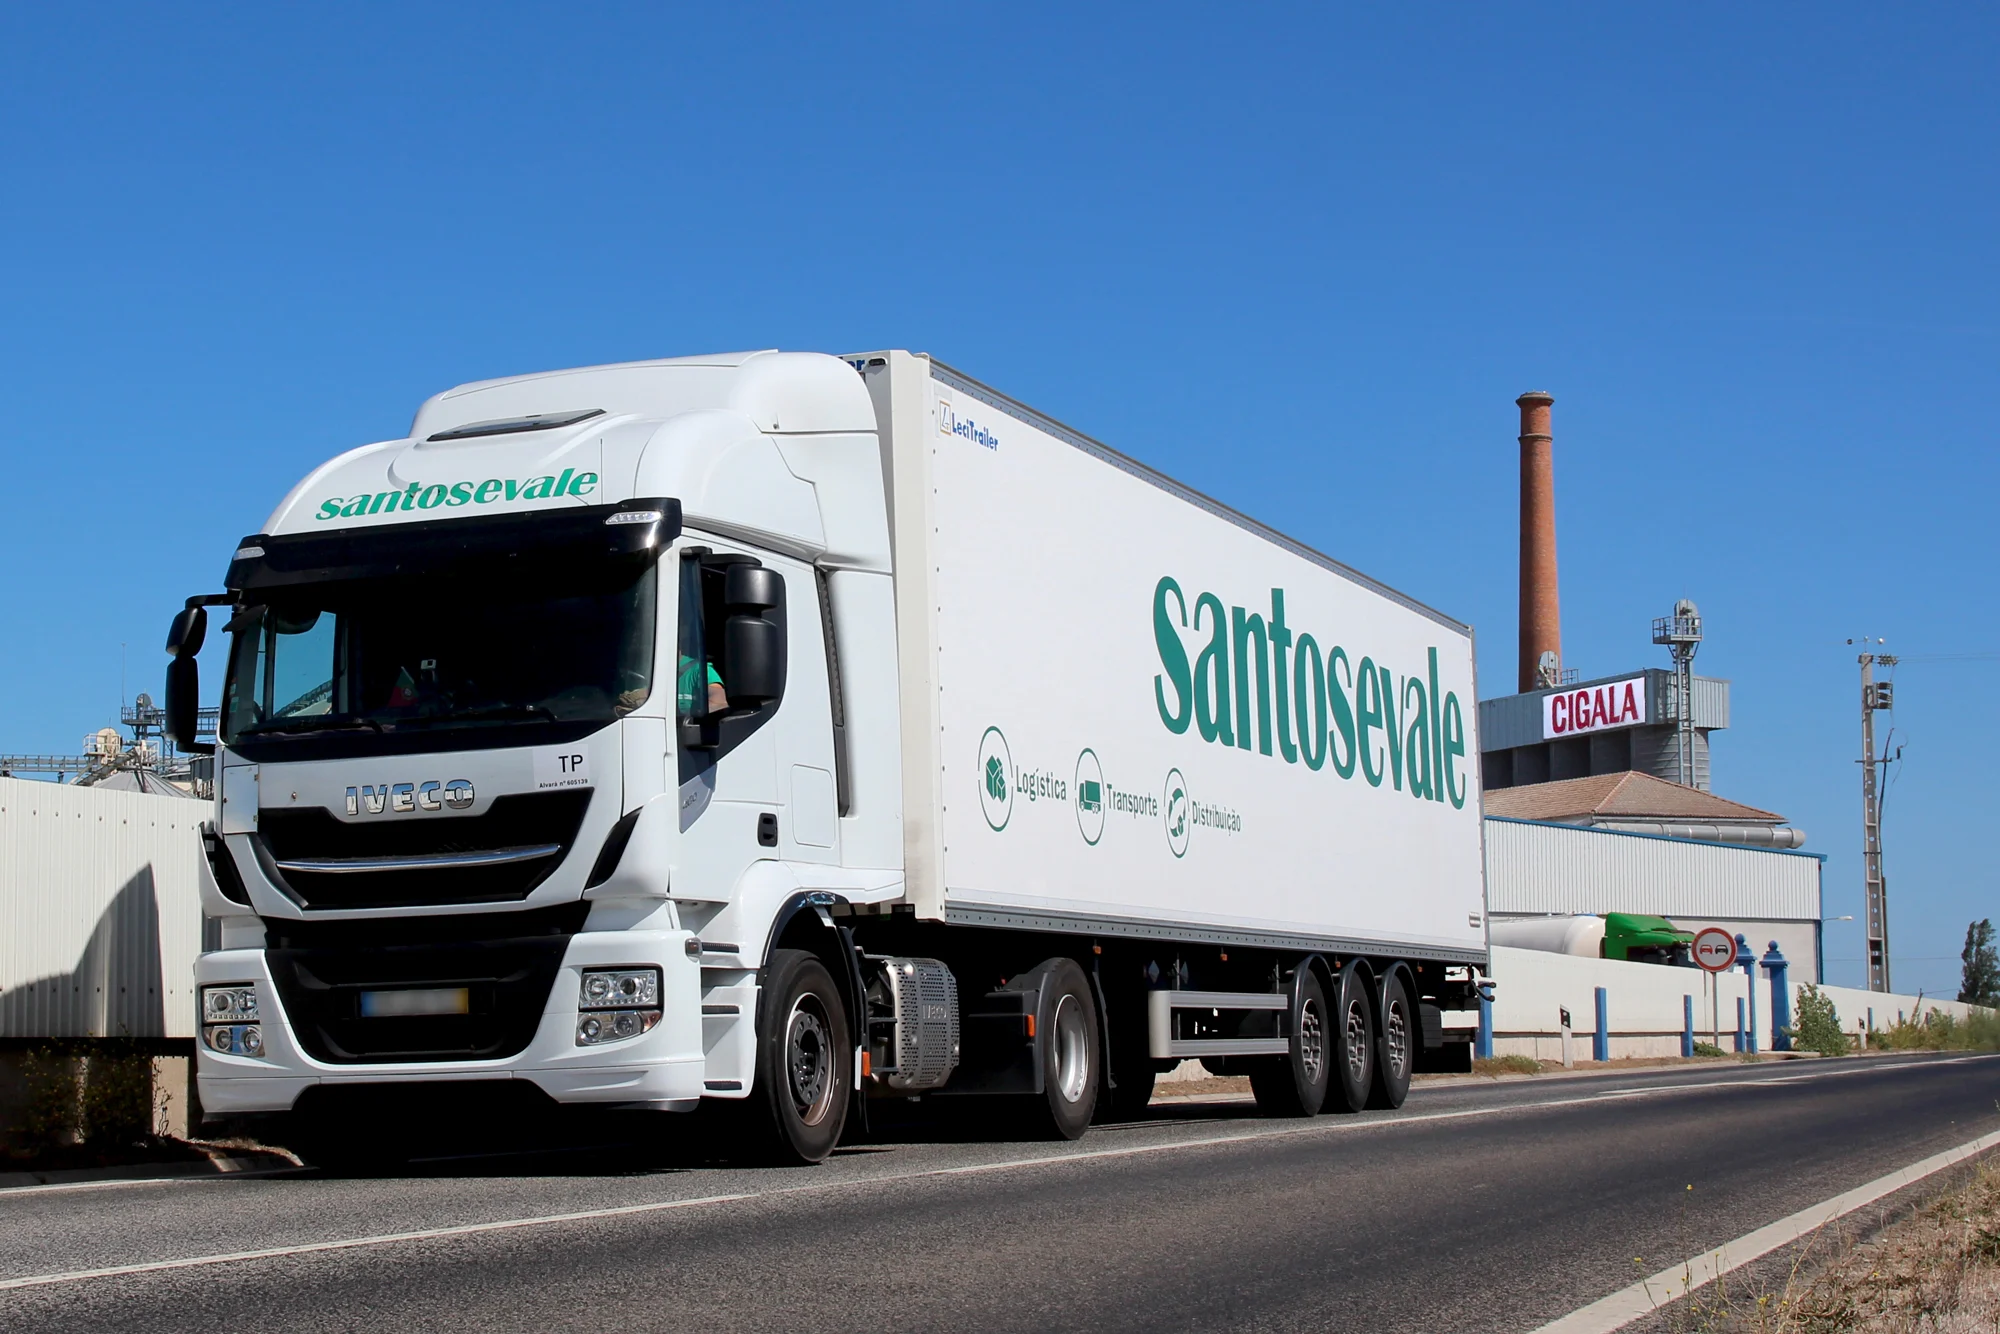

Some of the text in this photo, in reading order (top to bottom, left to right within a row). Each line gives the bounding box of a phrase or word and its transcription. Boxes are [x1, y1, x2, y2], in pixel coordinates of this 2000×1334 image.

[951, 412, 999, 451] LeciTrailer
[315, 467, 599, 521] santosevale
[1152, 575, 1466, 810] santosevale
[1552, 682, 1639, 734] CIGALA
[558, 754, 583, 773] TP
[1015, 764, 1067, 801] Logística
[345, 778, 475, 816] IVECO
[1106, 783, 1158, 819] Transporte
[1192, 800, 1241, 836] Distribuição
